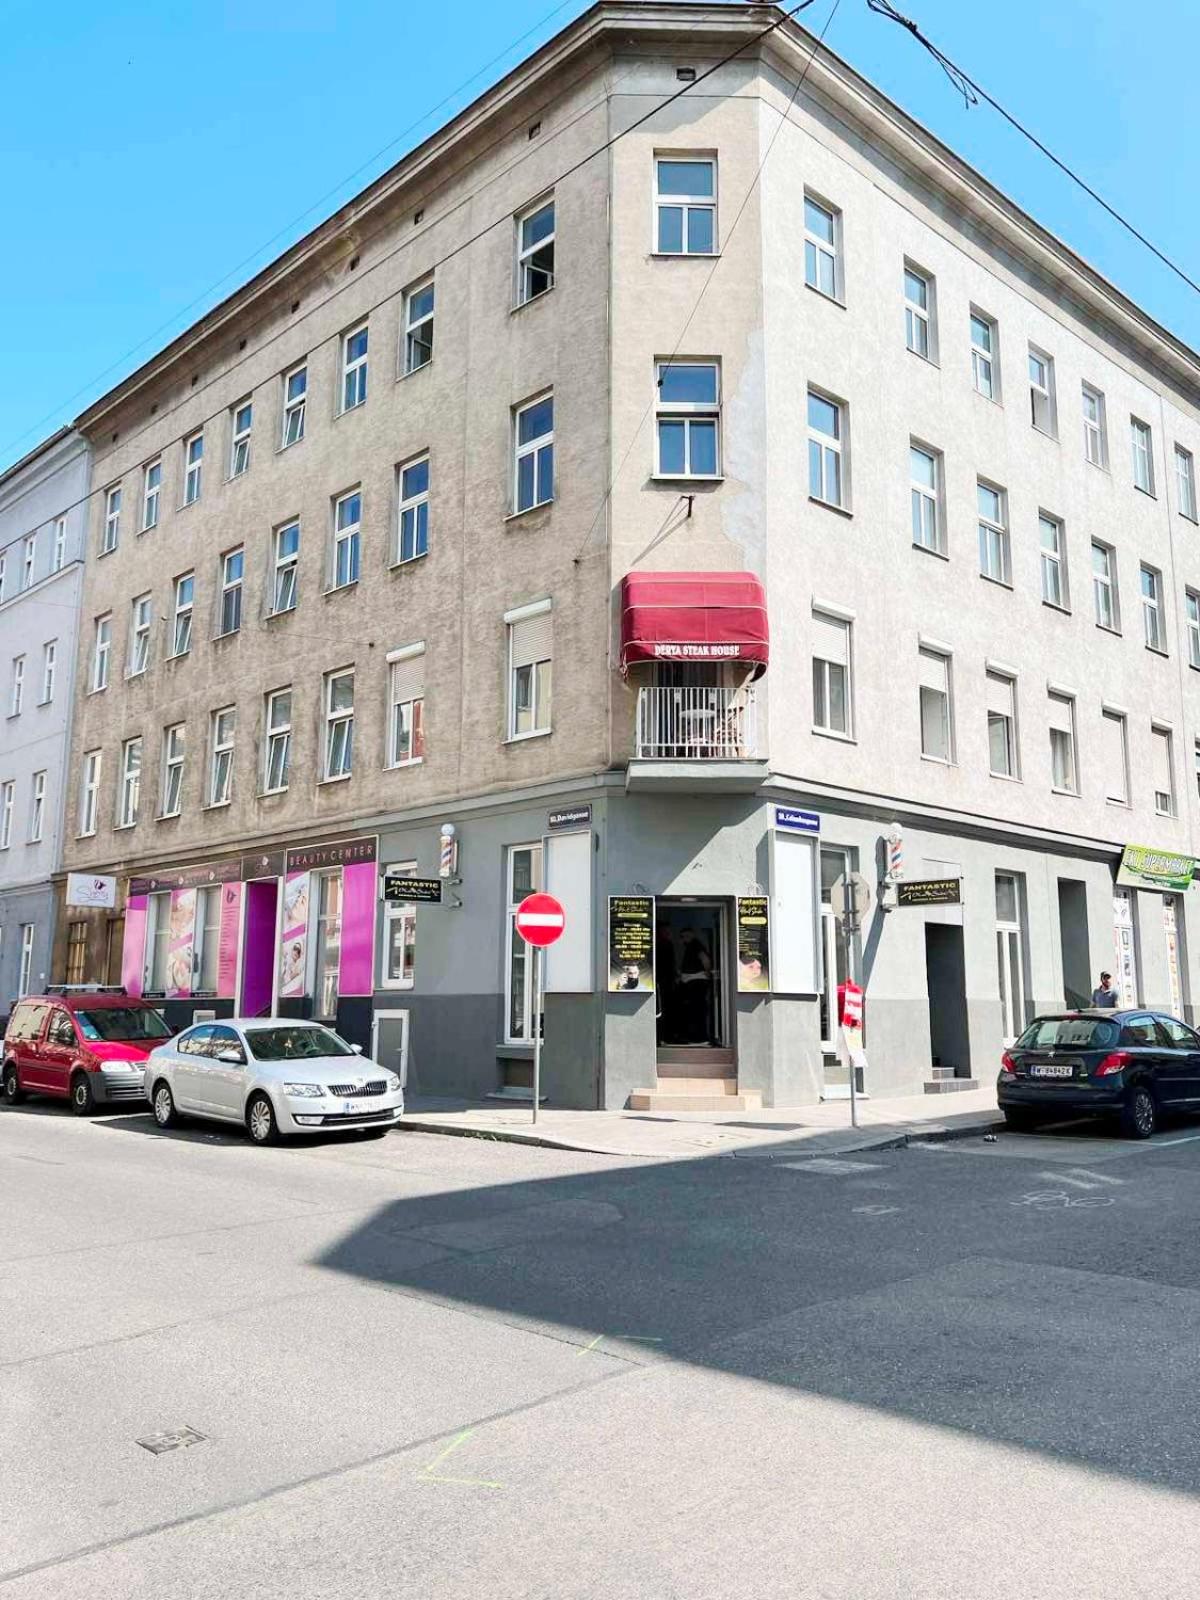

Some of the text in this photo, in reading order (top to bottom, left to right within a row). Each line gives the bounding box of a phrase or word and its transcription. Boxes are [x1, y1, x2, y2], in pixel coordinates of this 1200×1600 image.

[683, 645, 709, 656] STEAK
[711, 645, 740, 656] HOUSE
[289, 845, 373, 866] BEAUTY CENTER
[390, 880, 439, 889] FANTASTIC
[903, 882, 956, 891] FANTASTIC
[739, 898, 768, 906] Fantastic
